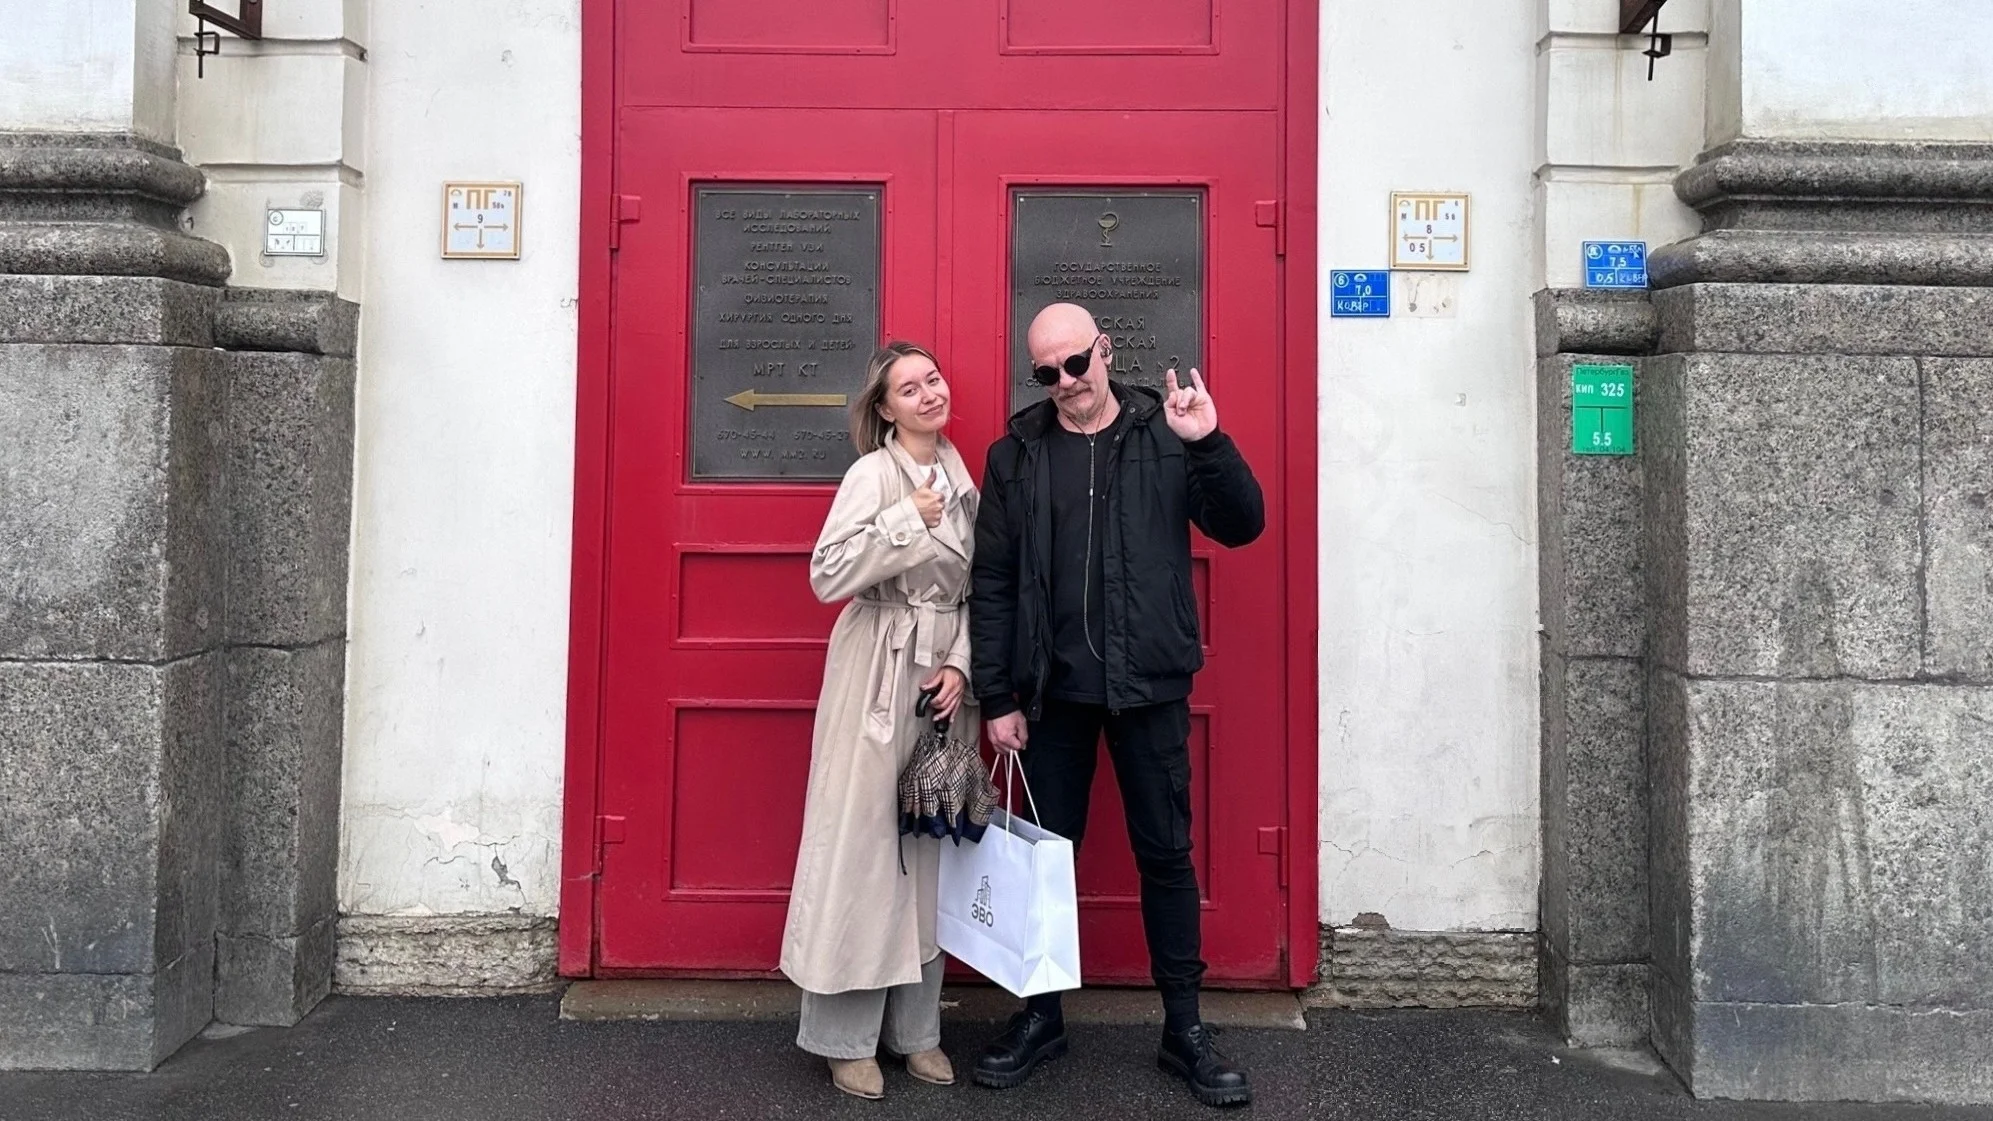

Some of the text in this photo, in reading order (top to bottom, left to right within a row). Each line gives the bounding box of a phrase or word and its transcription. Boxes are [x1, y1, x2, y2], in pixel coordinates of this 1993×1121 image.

[466, 190, 497, 210] ПГ
[779, 210, 861, 221] ЛАБОРАТОРНЫХ
[1415, 200, 1445, 220] ПГ
[477, 214, 484, 224] 9
[743, 223, 831, 233] ИССЛЕДОВАНИЙ
[1426, 224, 1432, 234] 8
[744, 261, 829, 272] КОНСУЛЬТАЦИИ
[1054, 262, 1161, 272] ГОСУДАРСТВЕННОЕ
[1034, 275, 1181, 287] БЮДЖЕТНОЕ УЧРЕЖДЕНИЕ
[1338, 275, 1345, 285] 6
[745, 294, 829, 304] ФИЗИОТЕРАПИЯ
[1056, 289, 1159, 300] ЗДРАВООХРАНЕНИЯ
[719, 313, 853, 324] ХИРУРГИЯ ОДНОГО ДНЯ
[719, 338, 854, 350] ДЛЯ ВЗРОСЛЫХ И ДЕТЕЙ
[753, 362, 819, 376] МРТ КТ
[1601, 383, 1625, 397] 325
[971, 903, 994, 928] ЭВО
